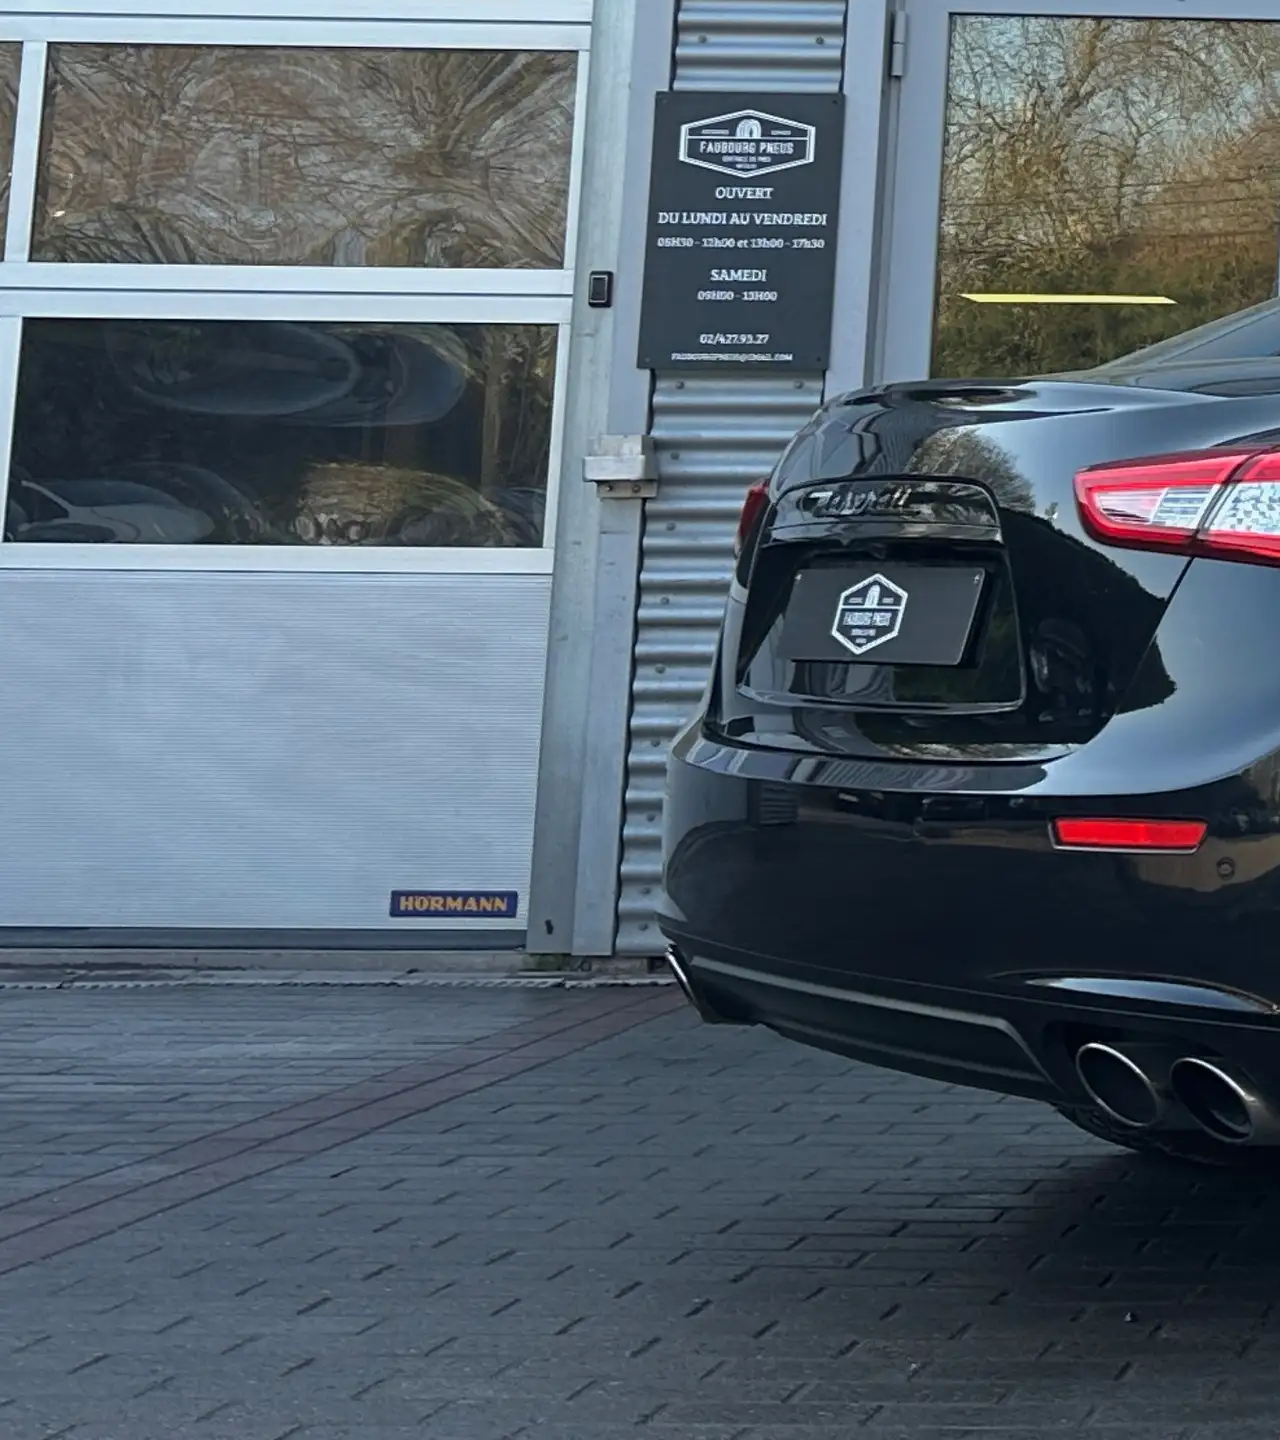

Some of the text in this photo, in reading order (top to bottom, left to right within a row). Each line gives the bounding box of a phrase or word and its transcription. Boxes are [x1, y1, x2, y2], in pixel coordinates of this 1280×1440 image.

[700, 141, 794, 155] FAUBOURG PNEUS
[715, 186, 774, 199] OUVERT
[657, 212, 828, 226] DU LUNDI AU VENDREDI
[737, 238, 749, 248] et
[710, 269, 767, 282] SAMEDI
